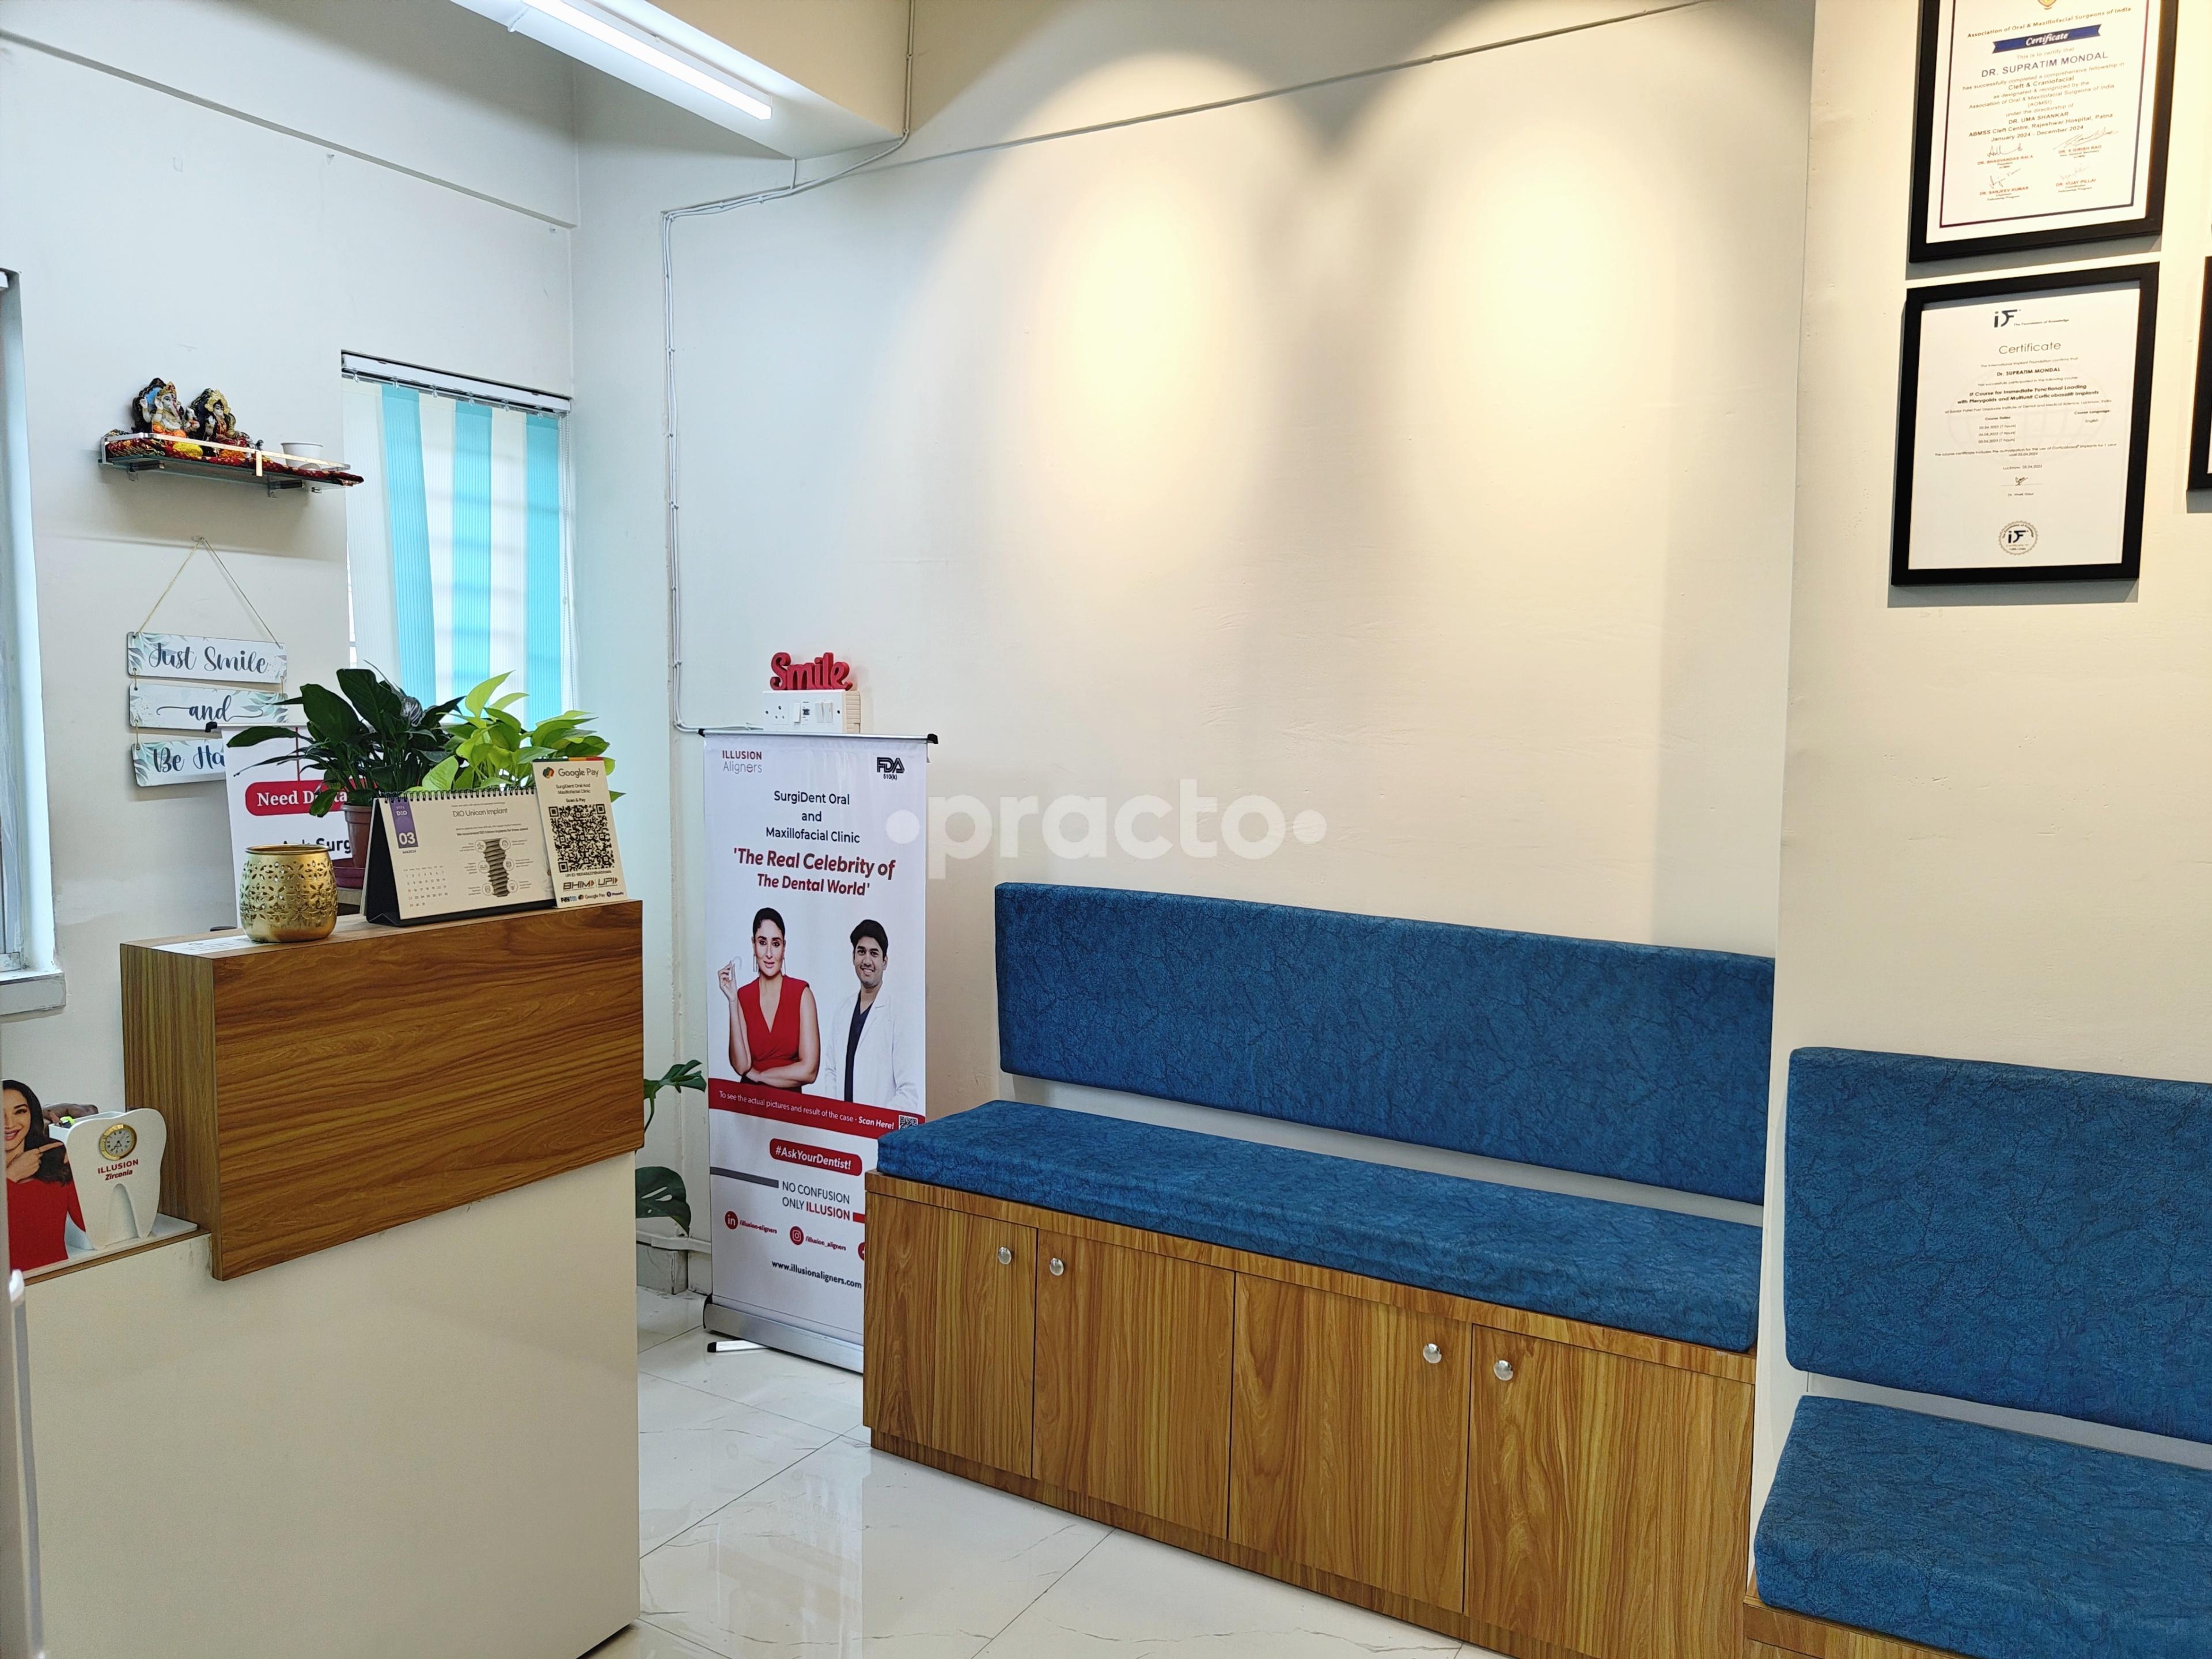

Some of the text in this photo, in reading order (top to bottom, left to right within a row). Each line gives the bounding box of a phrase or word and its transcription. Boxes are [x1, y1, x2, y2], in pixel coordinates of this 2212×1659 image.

[1967, 28, 2002, 38] Association
[2033, 16, 2073, 27] Maxillofacial
[2075, 11, 2105, 20] Surgeons
[2025, 32, 2069, 46] Certificate
[1981, 51, 2109, 78] DR. SUPRATIM MONDAL
[1974, 80, 2007, 89] successfully
[2008, 75, 2037, 84] completed
[2044, 69, 2087, 78] comprehensive
[2033, 75, 2074, 86] Craniofacial
[2028, 92, 2062, 100] Maxillofacial
[2064, 87, 2092, 96] Surgeons
[2037, 111, 2069, 120] SHANKAR
[2032, 120, 2064, 129] Rajeshwar
[1991, 134, 2016, 142] January
[2036, 127, 2067, 136] December
[1998, 342, 2061, 354] Certificate
[149, 642, 270, 674] Just Smile
[770, 652, 853, 691] Smile
[153, 747, 184, 773] Be
[722, 750, 905, 774] ILLUSION FDA
[722, 761, 763, 775] Aligners
[558, 767, 599, 778] Google Pay
[257, 790, 299, 807] Need
[774, 790, 850, 805] SurgiDent Oral
[487, 808, 508, 816] Implant
[801, 811, 822, 822] and
[399, 832, 415, 845] 03
[766, 827, 860, 843] Maxillofacial Clinic
[767, 850, 800, 869] Real
[803, 853, 875, 878] Celebrity
[877, 859, 896, 880] of
[563, 877, 615, 890] BHIM UPI
[757, 873, 779, 888] The
[782, 875, 824, 892] Dental
[719, 1090, 726, 1099] To
[737, 1094, 747, 1103] the
[748, 1097, 765, 1105] actual
[766, 1101, 790, 1110] pictures
[803, 1107, 820, 1116] result
[821, 1109, 828, 1118] of
[828, 1111, 839, 1120] the
[839, 1115, 854, 1123] case
[858, 1116, 874, 1126] Scan
[876, 1119, 895, 1130] Here!
[775, 1145, 852, 1171] #AskYourDentist!
[97, 1158, 139, 1175] ILLUSION
[105, 1169, 133, 1181] Zirconia
[782, 1180, 850, 1205] NO CONFUSION
[782, 1196, 850, 1221] ONLY ILLUSION
[771, 1260, 862, 1289] www.illusionaligners.com
